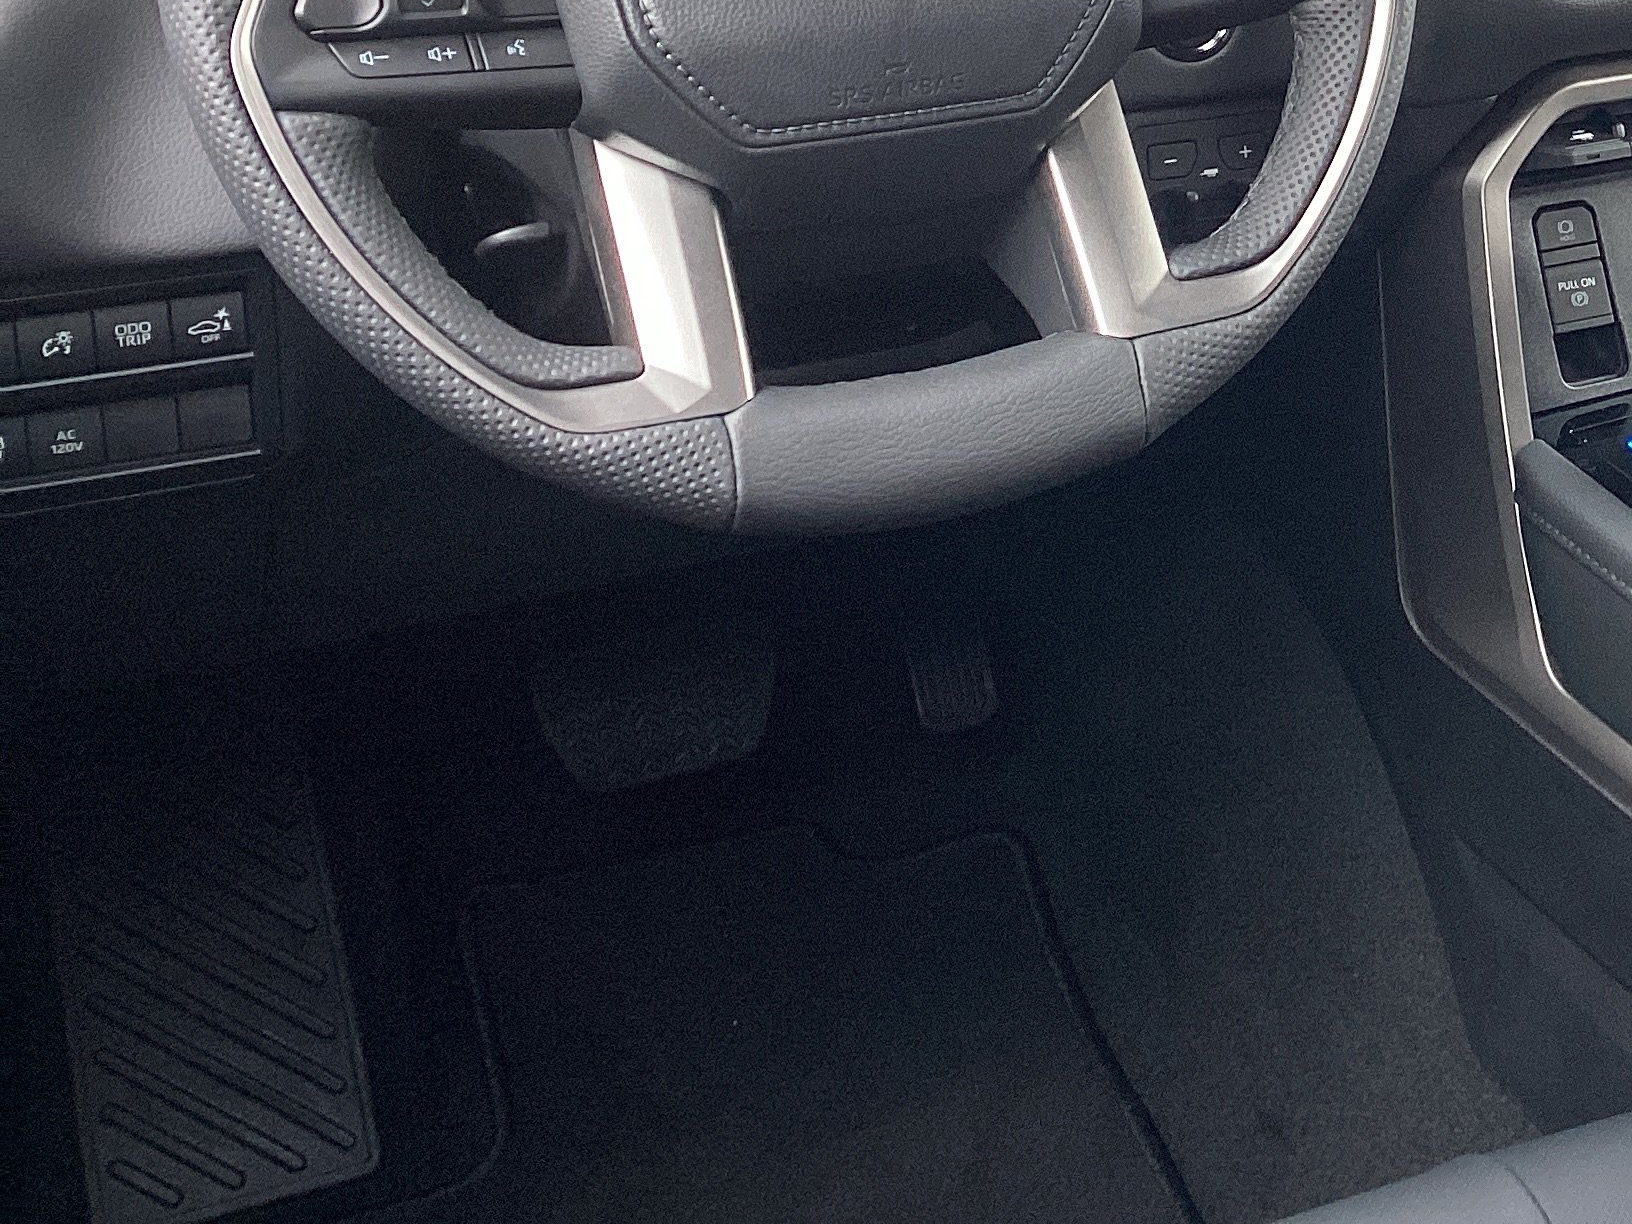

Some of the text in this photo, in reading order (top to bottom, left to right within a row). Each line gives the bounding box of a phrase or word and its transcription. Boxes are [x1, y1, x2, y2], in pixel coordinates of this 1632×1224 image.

[1558, 277, 1596, 291] PULL ON
[115, 321, 151, 336] ODO
[117, 333, 151, 347] TRIP
[201, 333, 220, 344] OFF
[57, 429, 76, 440] AC
[51, 441, 83, 454] 120V
